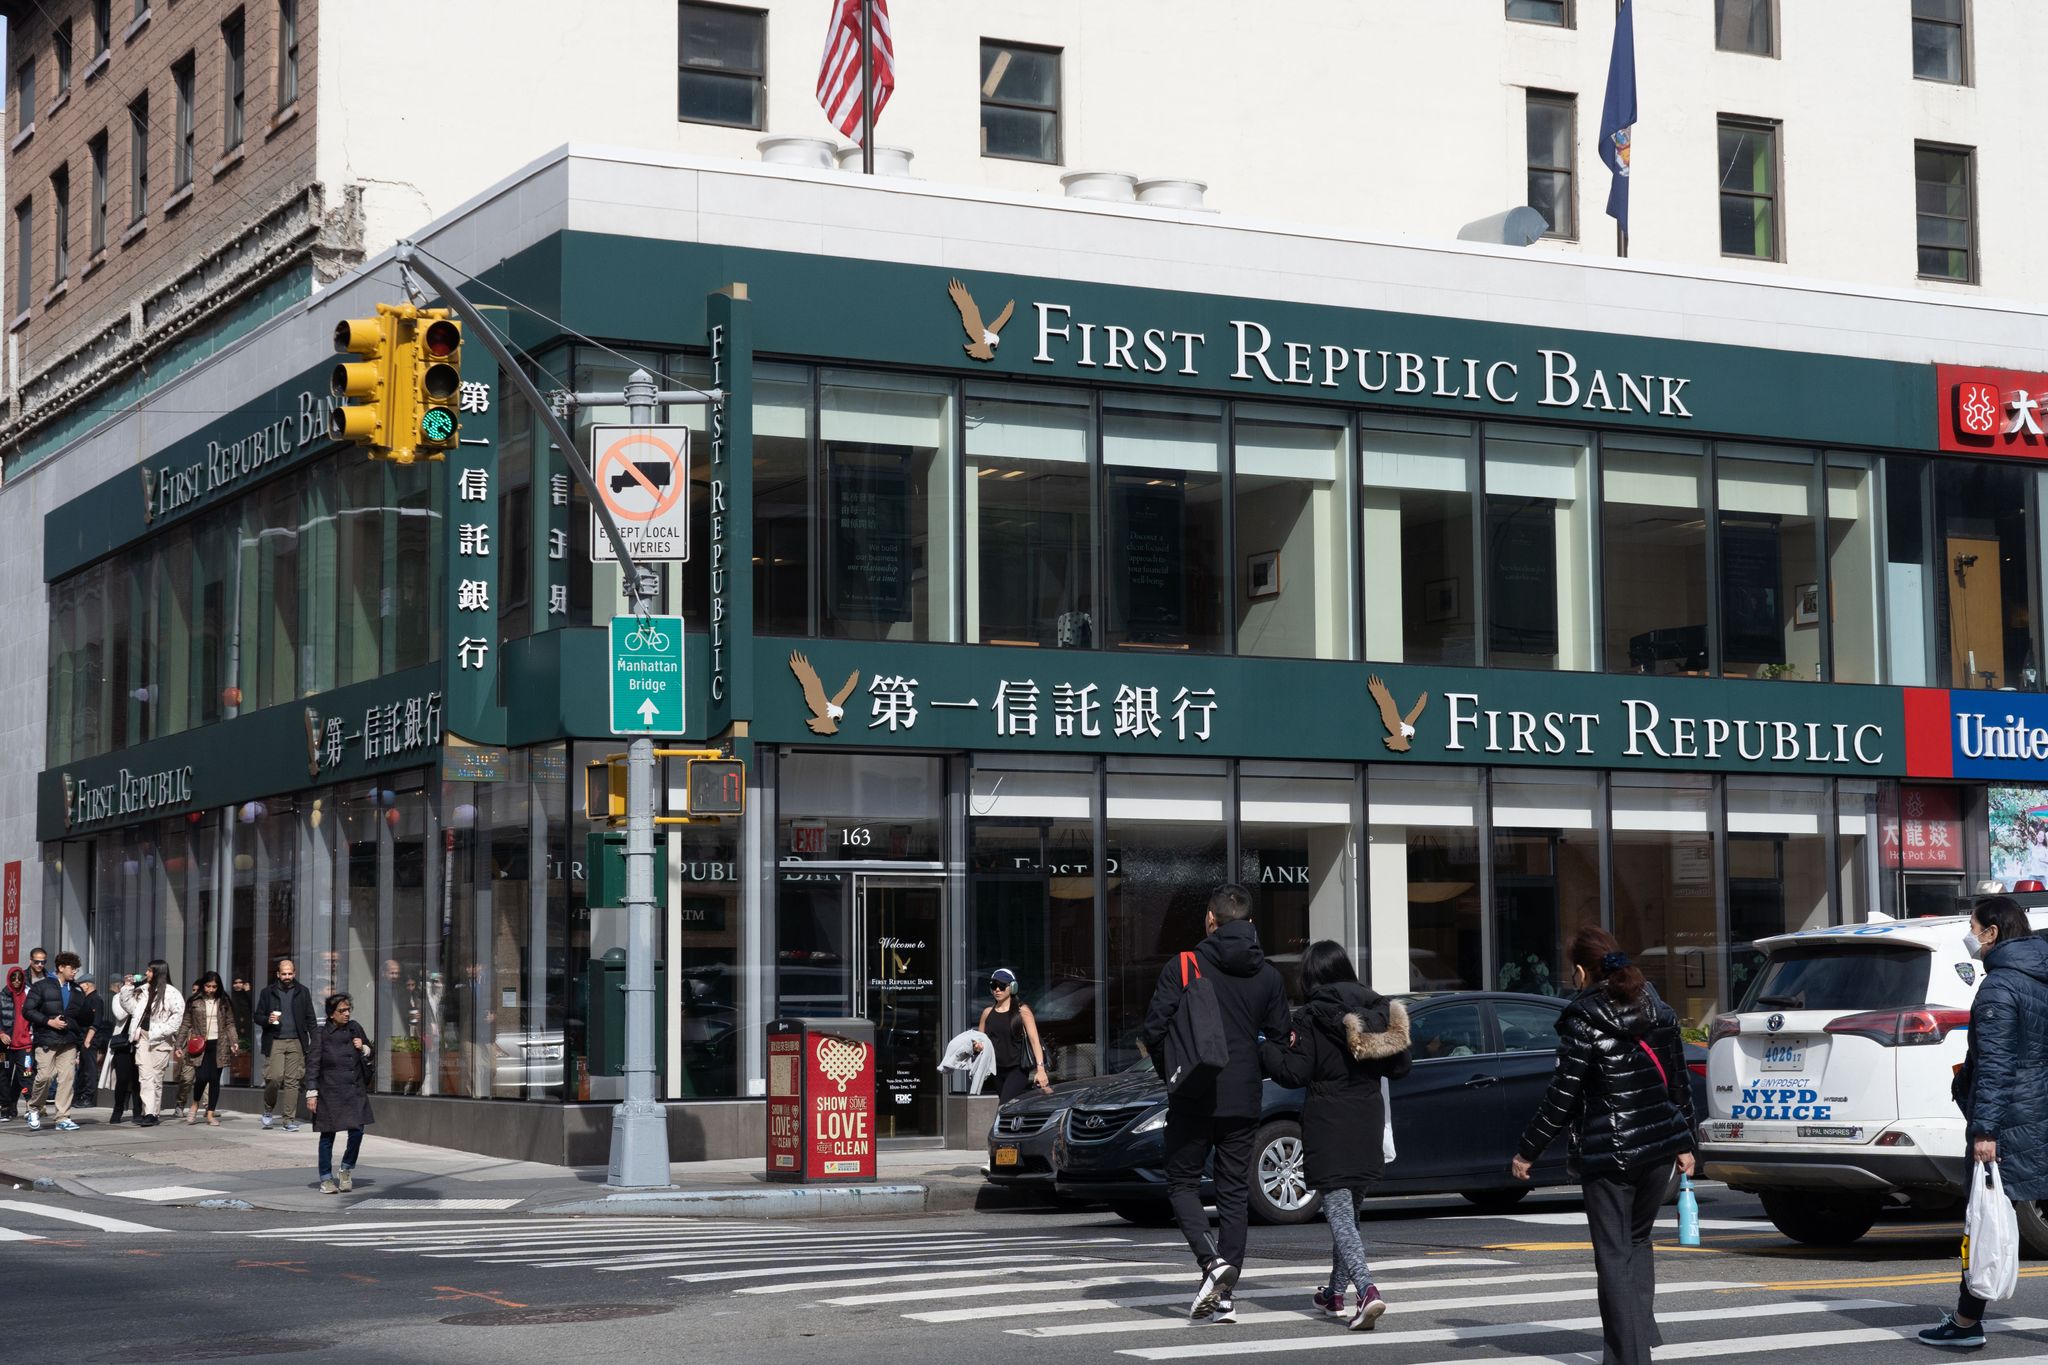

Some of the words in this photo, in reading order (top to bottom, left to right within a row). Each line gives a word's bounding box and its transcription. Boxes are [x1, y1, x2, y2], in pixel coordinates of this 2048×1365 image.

[1033, 302, 1205, 375] FIRST
[1230, 320, 1519, 404] REPUBLIC
[1537, 349, 1693, 417] BANK
[159, 462, 202, 515] FIRST
[207, 416, 292, 491] REPUBLIC
[297, 391, 348, 447] BAN
[458, 381, 490, 669] 第一信託銀行
[600, 527, 640, 538] EEPT
[646, 526, 680, 538] LOCAL
[609, 541, 671, 553] DIVERIES
[711, 480, 726, 701] REPUBLIC
[617, 660, 678, 673] Manhattan
[629, 679, 667, 693] Bridge
[868, 674, 1218, 740] 第一信託銀行
[326, 690, 442, 767] 第一信託銀行
[1444, 693, 1600, 755] FIRST
[1622, 700, 1883, 764] REPUBLIC
[77, 779, 115, 823] FIRST
[119, 765, 193, 815] REPUBLIC
[796, 828, 826, 851] EXIT
[842, 828, 871, 846] 163
[1908, 850, 1924, 861] Pot
[1261, 866, 1309, 884] ANK
[878, 937, 916, 949] Welcome
[917, 940, 926, 949] to
[1765, 1046, 1793, 1062] 4026
[1793, 1054, 1801, 1062] 17
[1761, 1078, 1810, 1088] @NYPD5PCT
[817, 1096, 848, 1111] SHOW
[849, 1098, 867, 1109] SOME
[895, 1093, 912, 1102] FDIC
[1742, 1089, 1818, 1104] NYPD
[1732, 1105, 1831, 1120] POLICE
[771, 1116, 791, 1136] LOVE
[816, 1112, 868, 1140] LOVE
[1823, 1128, 1850, 1136] INSPIRES
[778, 1138, 791, 1149] CLEAN
[834, 1141, 868, 1155] CLEAN
